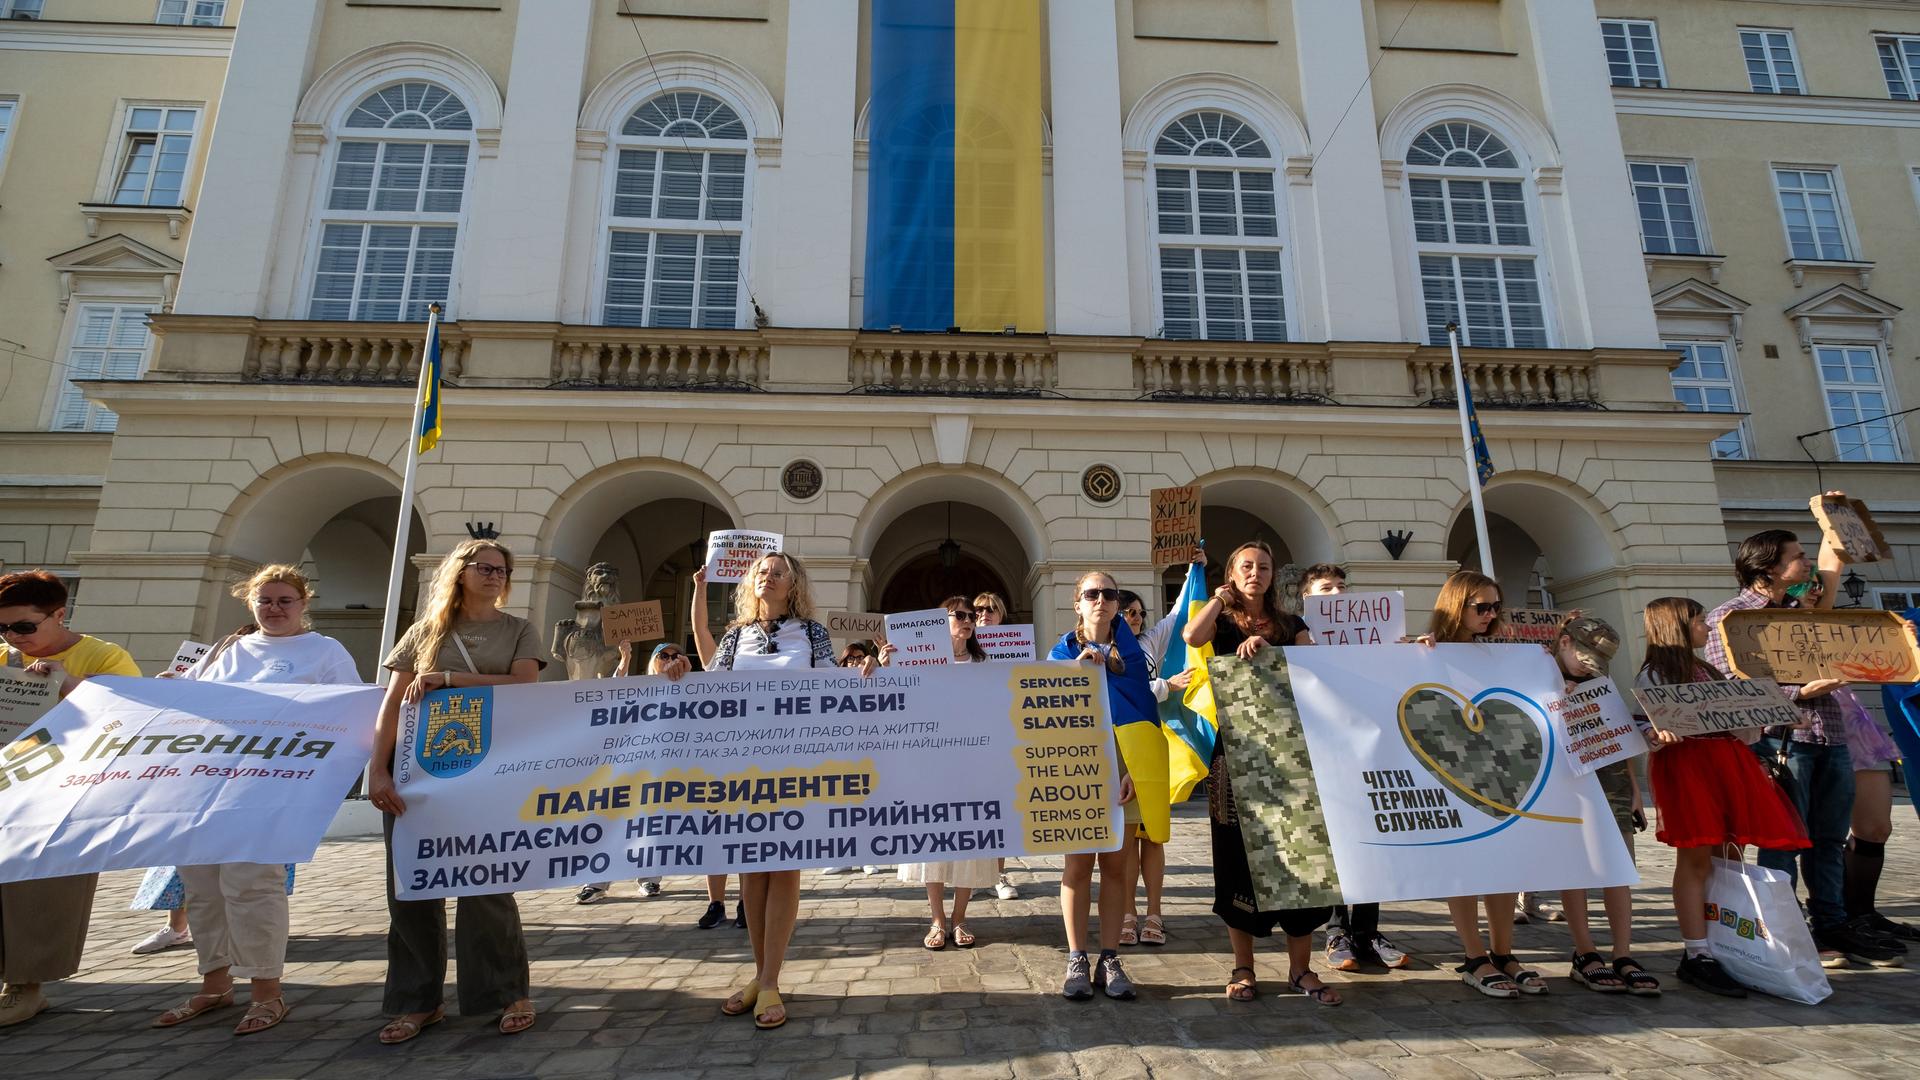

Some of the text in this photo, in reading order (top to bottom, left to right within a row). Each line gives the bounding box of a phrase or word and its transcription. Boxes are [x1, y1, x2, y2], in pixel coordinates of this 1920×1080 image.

[1159, 487, 1193, 503] ХОЧУ
[1156, 500, 1197, 519] ЖИТИ
[1154, 516, 1196, 534] СЕРЕД
[711, 541, 778, 551] ЛЬВІВ ВИМАГАЄ
[1153, 532, 1197, 550] ЖИВИХ
[717, 558, 752, 568] ТЕРМІ
[728, 549, 758, 559] ЧІТКІ
[608, 607, 653, 620] ЗАМІНИ
[635, 614, 660, 625] МЕНЕ
[1320, 597, 1390, 624] ЧЕКАЮ
[1510, 611, 1526, 624] НЕ
[611, 623, 659, 639] Я НА МЕЖІ
[830, 616, 881, 633] СКІЛЬКИ
[890, 618, 946, 631] ВИМАГАЄМО
[976, 631, 1022, 640] ВИЗНАЧЕНІ
[1322, 627, 1381, 645] ТАТА
[1747, 624, 1885, 645] СТУДЕНТИ
[906, 643, 936, 653] ЧІТКІ
[999, 640, 1031, 648] СЛУЖБИ
[574, 675, 921, 703] БЕЗ ТЕРМІНІВ СЛУЖБИ НЕ БУДЕ МОБІЛІЗАЦІЇ!
[1019, 676, 1090, 689] SERVICES
[1568, 684, 1612, 705] ЧІТКИХ
[1643, 681, 1766, 704] ПРИЄДНАТИСЬ
[590, 698, 747, 727] ВІЙСЬКОВІ
[774, 696, 811, 716] НЕ
[820, 693, 906, 714] РАБИ!
[1697, 710, 1749, 731] МОЖЕ
[1748, 705, 1802, 727] КОЖЕН
[1023, 715, 1095, 730] SLAVES!
[1566, 716, 1605, 737] СЛУЖБИ
[603, 721, 939, 750] ВІЙСЬКОВІ ЗАСЛУЖИЛИ ПРАВО НА ЖИТТЯ!
[1570, 724, 1633, 754] ДЕМОТИВОВАНІ
[79, 731, 338, 762] Інтенція
[494, 735, 991, 776] ДАЙТЕ СПОКІЙ ЛЮДЯМ, ЯКІ І ТАК ЗА 2 РОКИ ВІДДАЛИ КРАЇНІ НАЙЦІННІШЕ!
[1025, 745, 1098, 759] SUPPORT
[431, 759, 473, 772] ЛЬВІВ
[1027, 763, 1100, 778] THE LAW
[60, 764, 315, 788] Задум. Дія. Результат!
[1362, 769, 1416, 789] ЧІТКІ
[536, 773, 871, 816] ПАНЕ ПРЕЗИДЕНТЕ!
[1029, 784, 1103, 803] ABOUT
[1367, 788, 1449, 811] ТЕРМІНИ
[1030, 807, 1106, 822] TERMS OF
[1375, 809, 1463, 833] СЛУЖБИ
[417, 800, 1001, 860] ВИМАГАЄМО НЕГАЙНОГО ПРИЙНЯТТЯ
[1032, 827, 1109, 843] SERVICE!
[410, 828, 1005, 891] ЗАКОНУ ПРО ЧІТКІ ТЕРМІНИ СЛУЖБИ!
